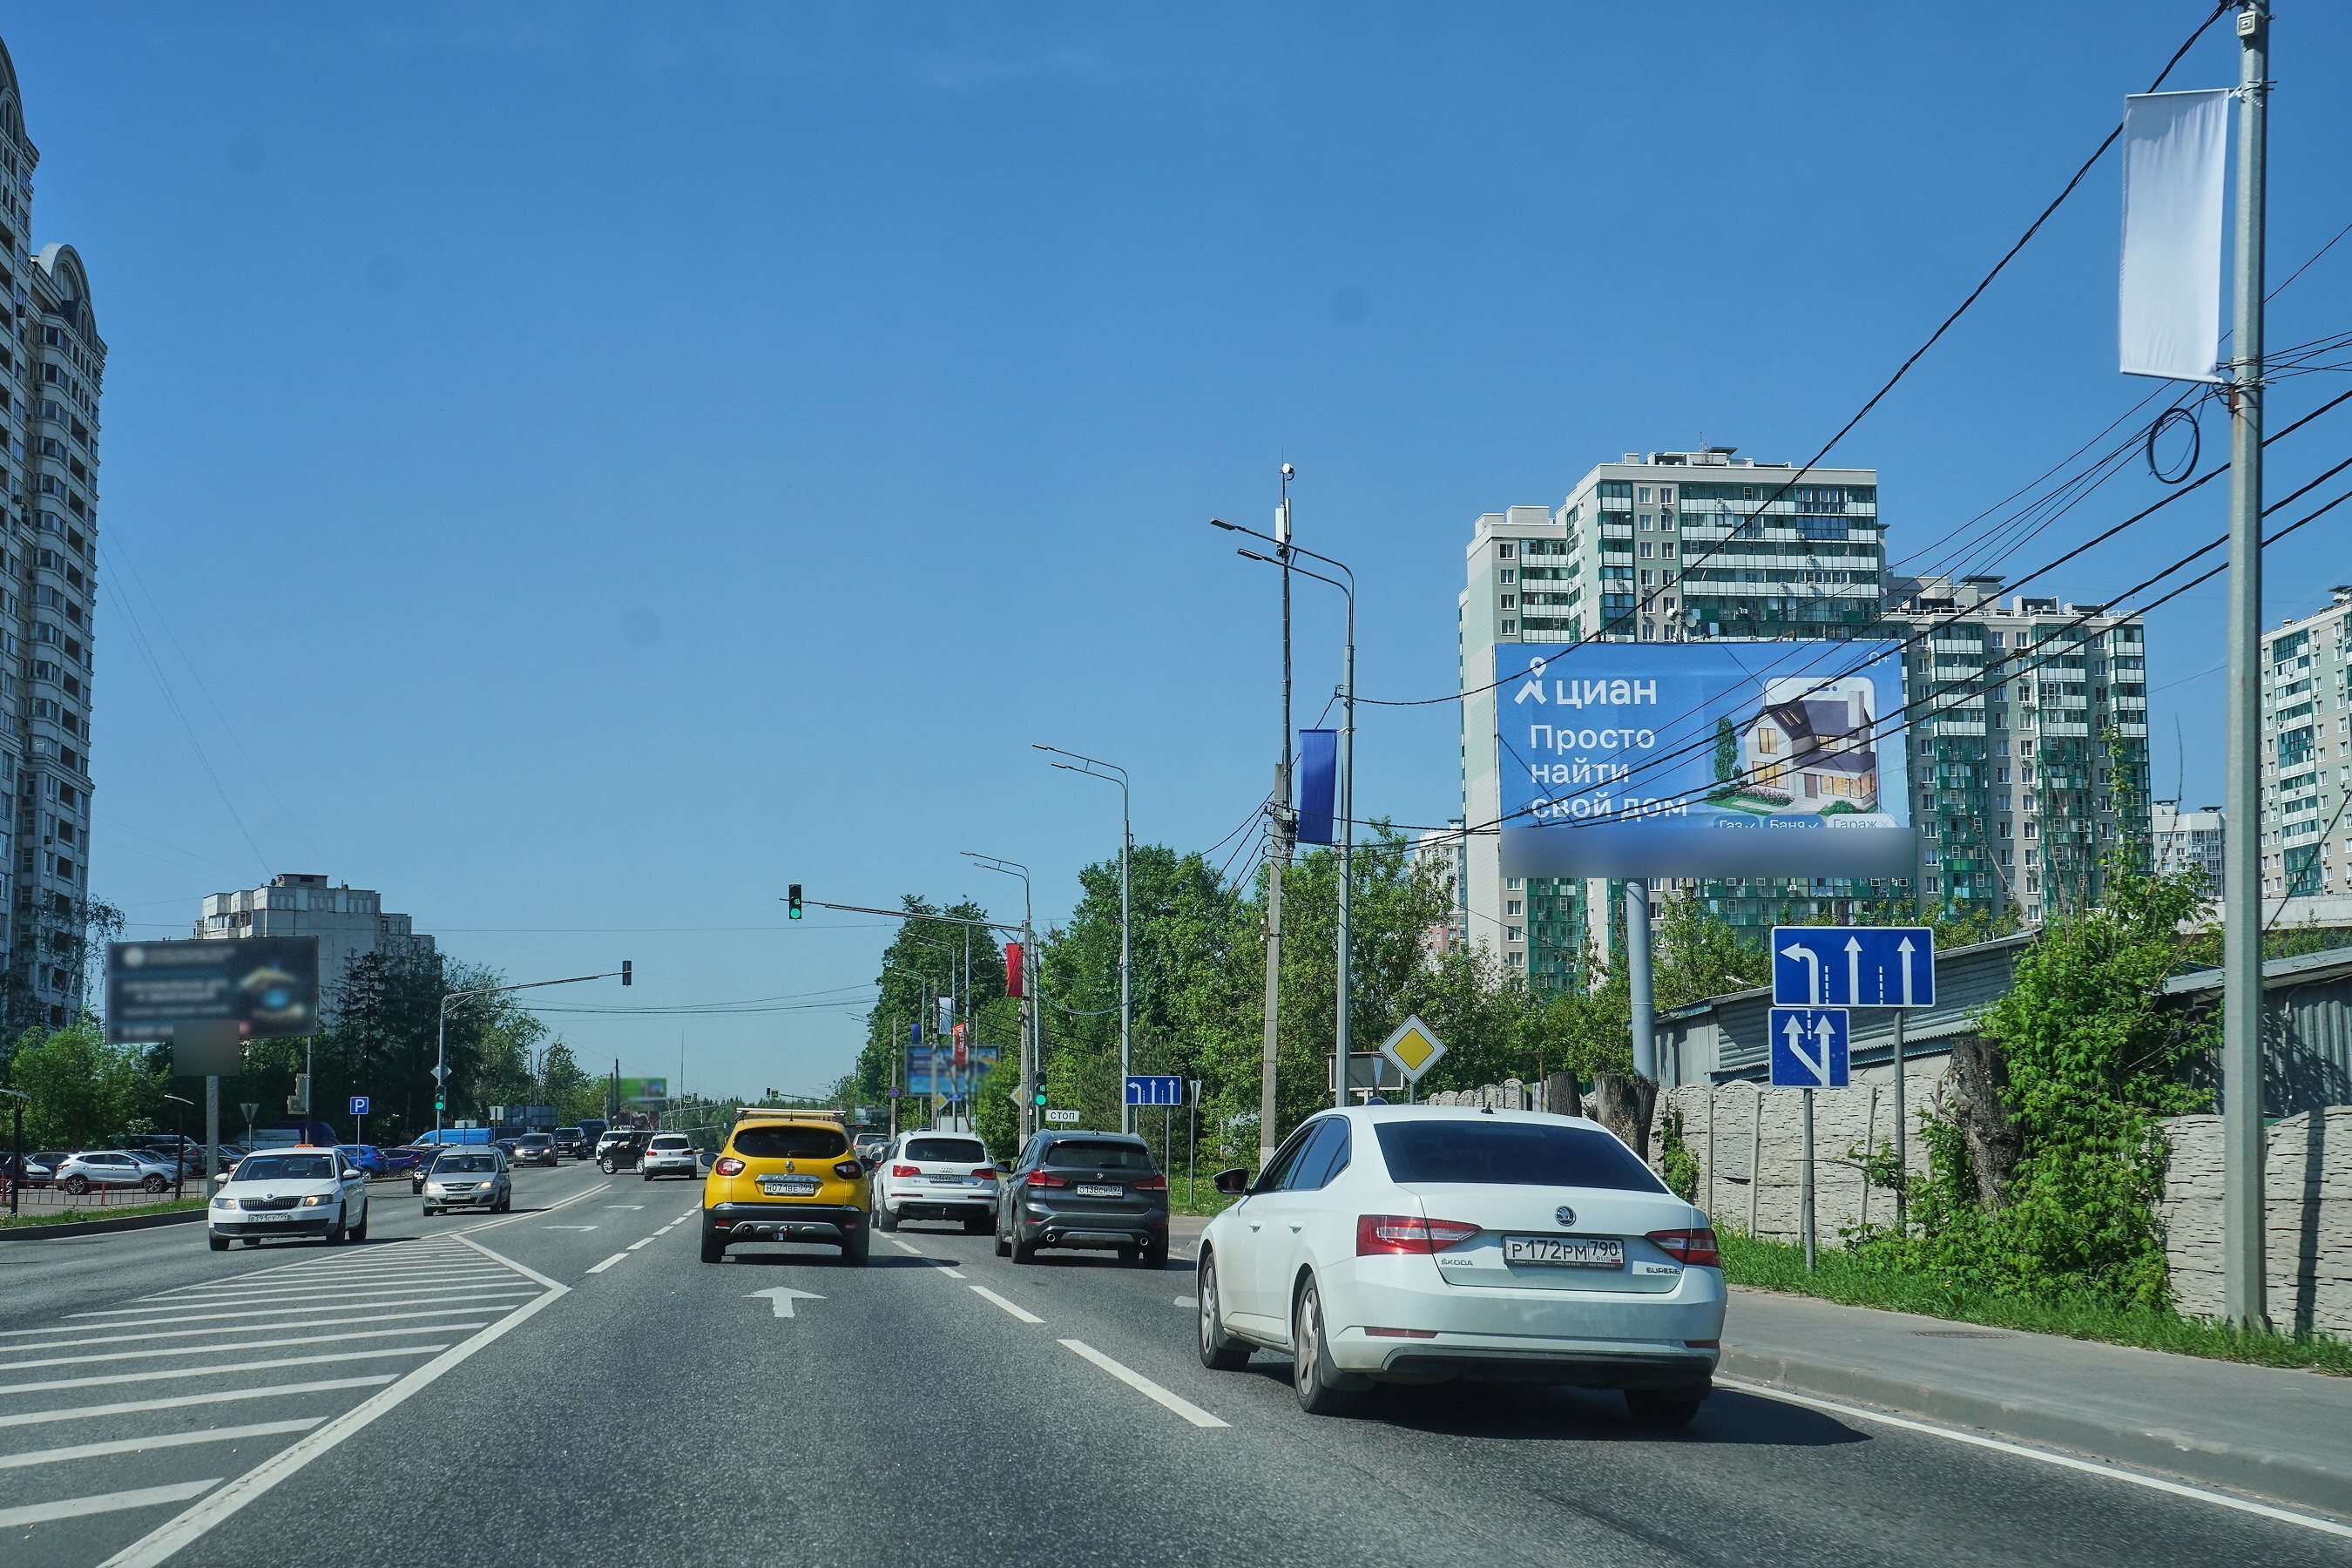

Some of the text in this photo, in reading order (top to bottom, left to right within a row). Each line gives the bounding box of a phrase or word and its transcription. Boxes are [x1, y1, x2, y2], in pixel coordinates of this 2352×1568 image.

[1556, 679, 1657, 710] циан
[1531, 724, 1656, 755] Просто
[1531, 757, 1629, 784] найти
[1531, 791, 1688, 822] свой дом
[355, 1098, 366, 1112] P
[1050, 1112, 1076, 1120] СТОП
